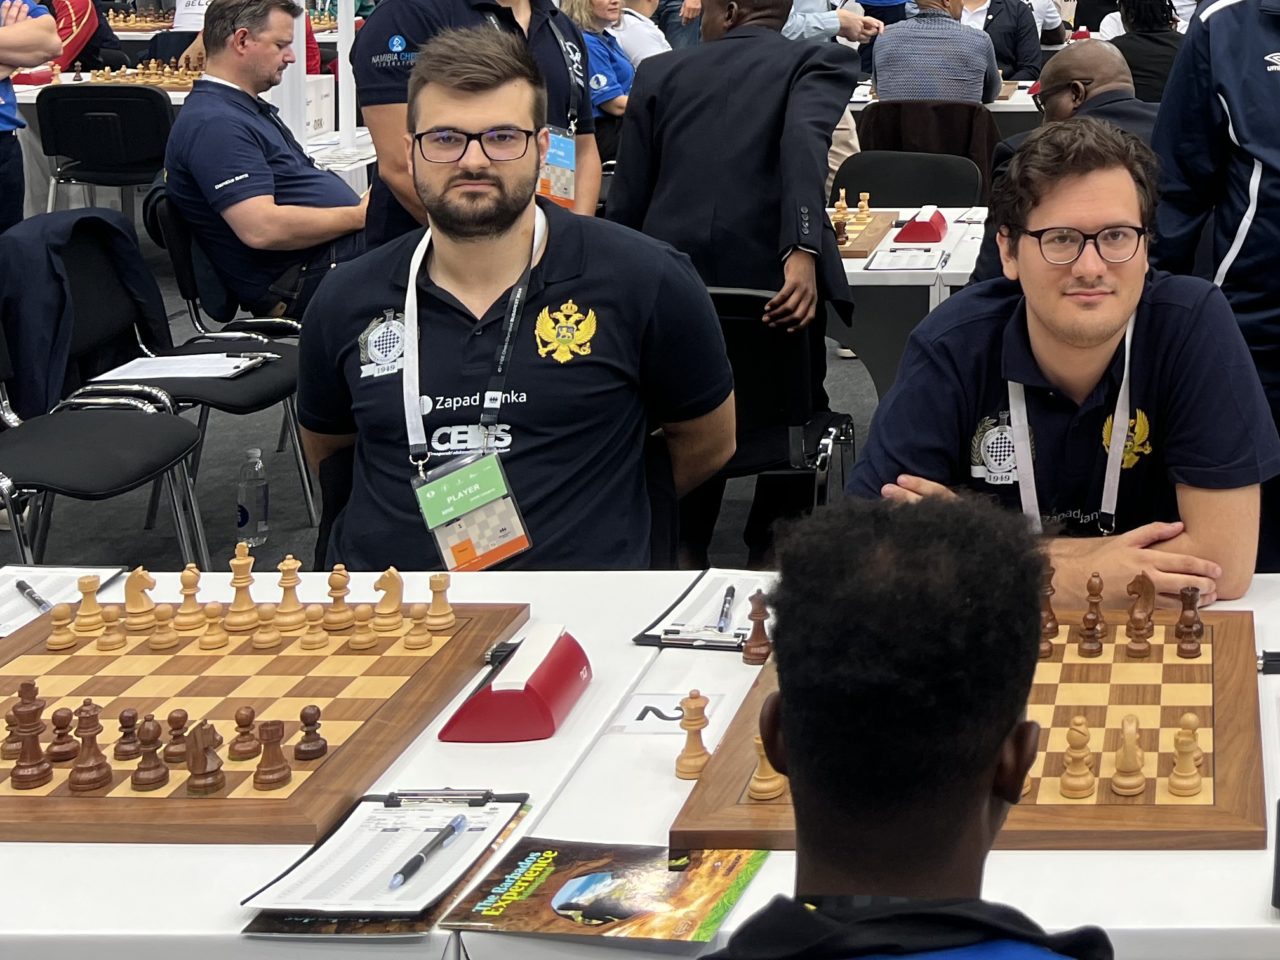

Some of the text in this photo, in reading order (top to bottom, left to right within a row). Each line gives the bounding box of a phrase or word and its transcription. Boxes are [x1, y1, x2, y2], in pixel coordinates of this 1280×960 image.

[371, 52, 398, 64] NAMIBIA
[375, 364, 397, 374] 1949
[435, 392, 480, 411] Zapad
[446, 483, 481, 504] PLAYER
[473, 894, 496, 913] The
[490, 851, 541, 895] Barbados
[481, 849, 558, 916] Experience
